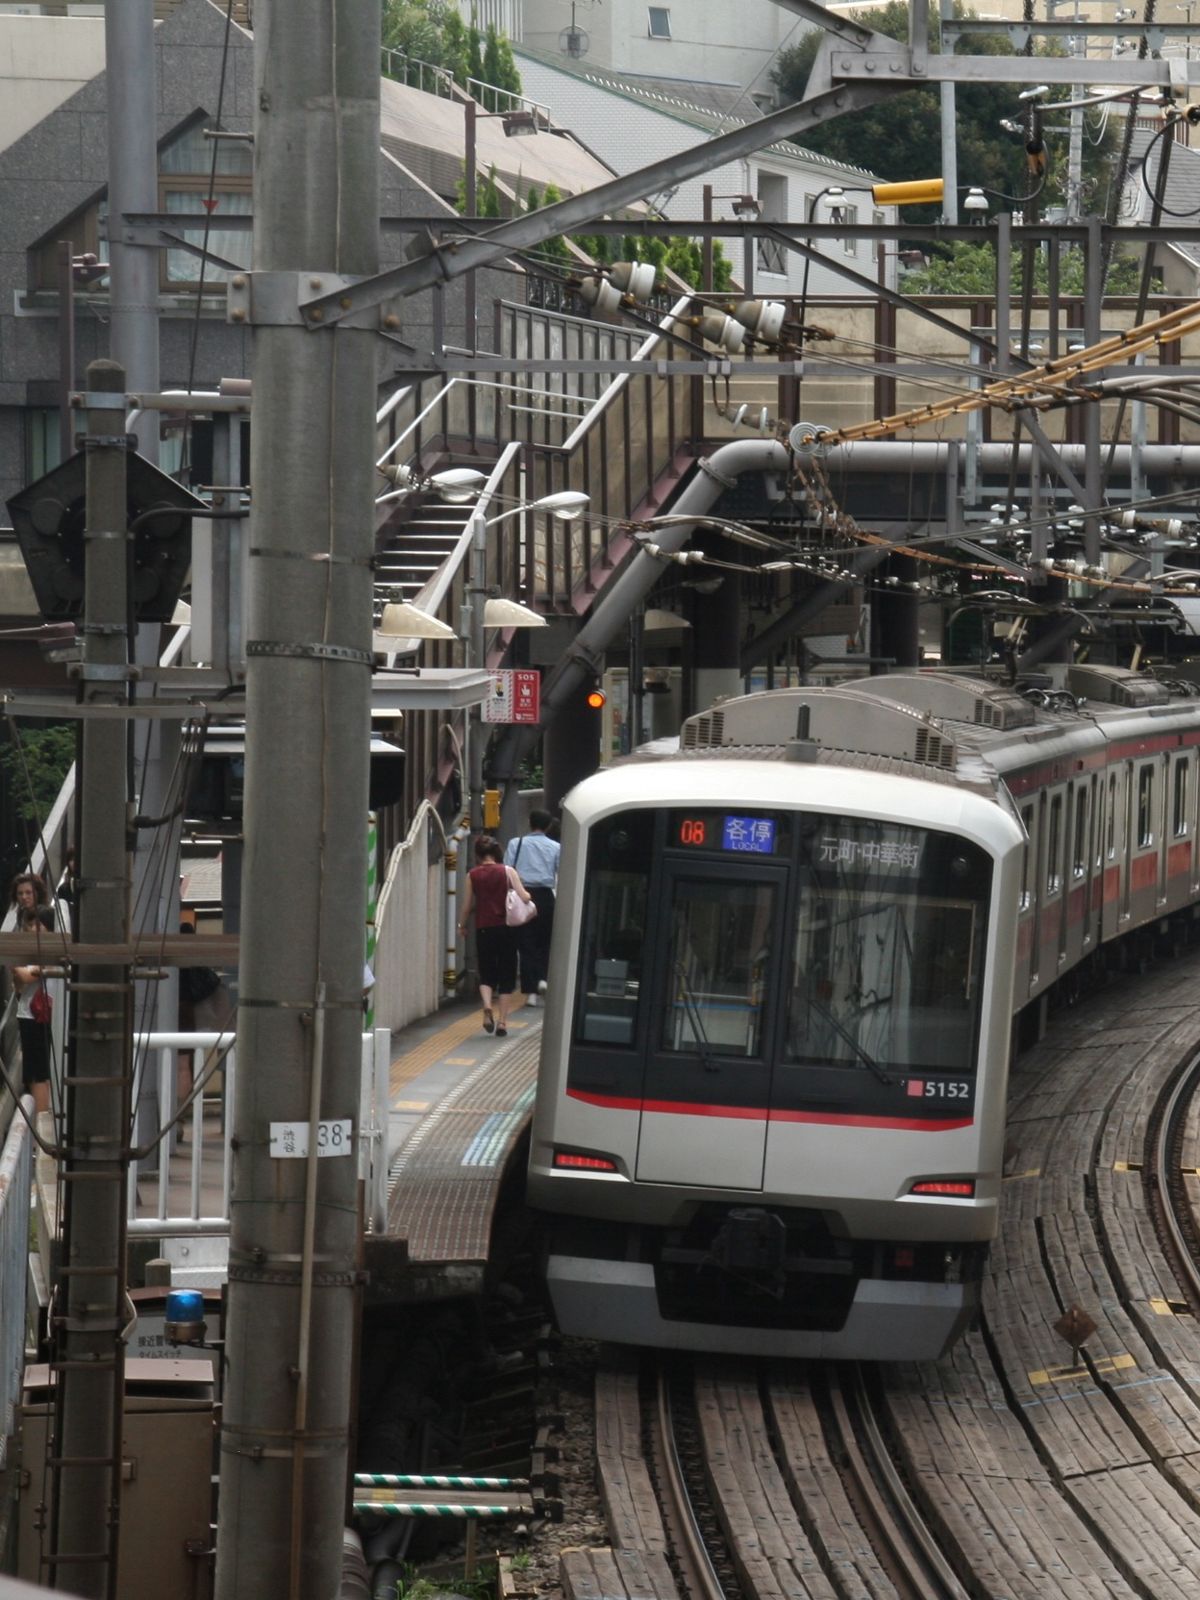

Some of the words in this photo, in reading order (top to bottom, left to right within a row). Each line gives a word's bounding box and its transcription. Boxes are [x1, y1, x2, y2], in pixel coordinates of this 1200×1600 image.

[517, 673, 535, 681] SOS
[681, 820, 704, 844] 08
[726, 819, 772, 842] 各停
[732, 840, 763, 852] LOCAL
[925, 1082, 969, 1098] 5152
